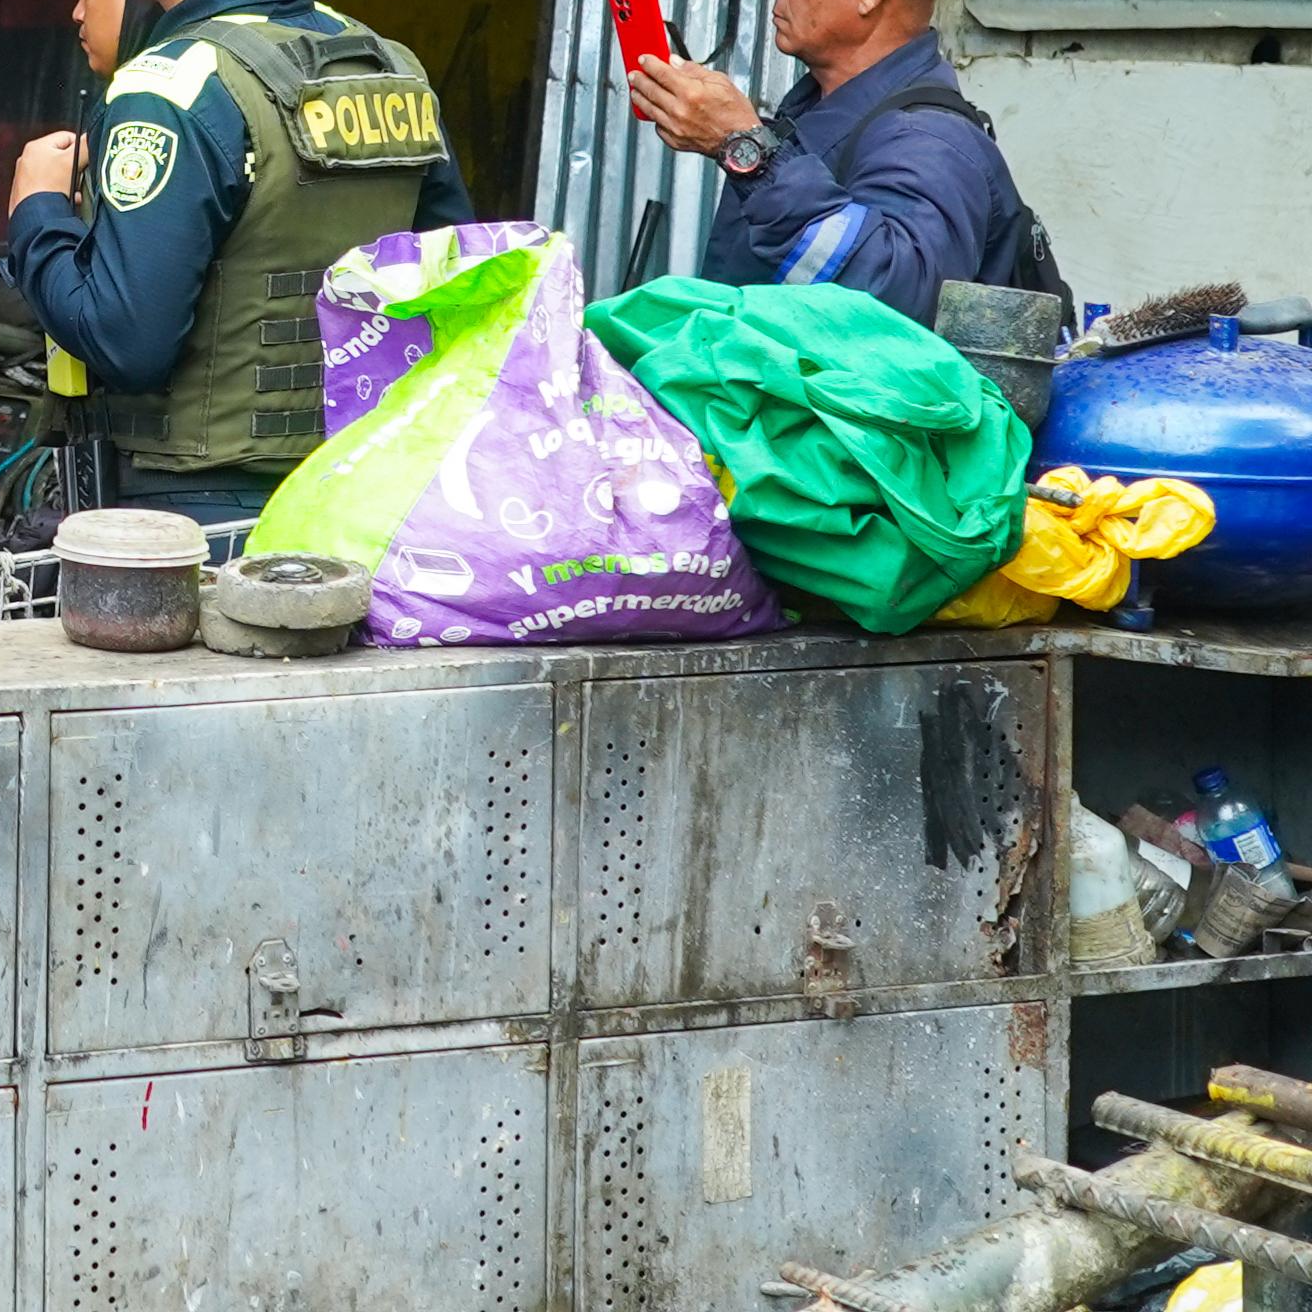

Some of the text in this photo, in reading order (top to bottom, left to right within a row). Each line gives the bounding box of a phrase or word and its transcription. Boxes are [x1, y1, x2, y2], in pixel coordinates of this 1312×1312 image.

[303, 91, 441, 149] POLICIA
[540, 551, 669, 586] menos
[672, 551, 711, 575] en
